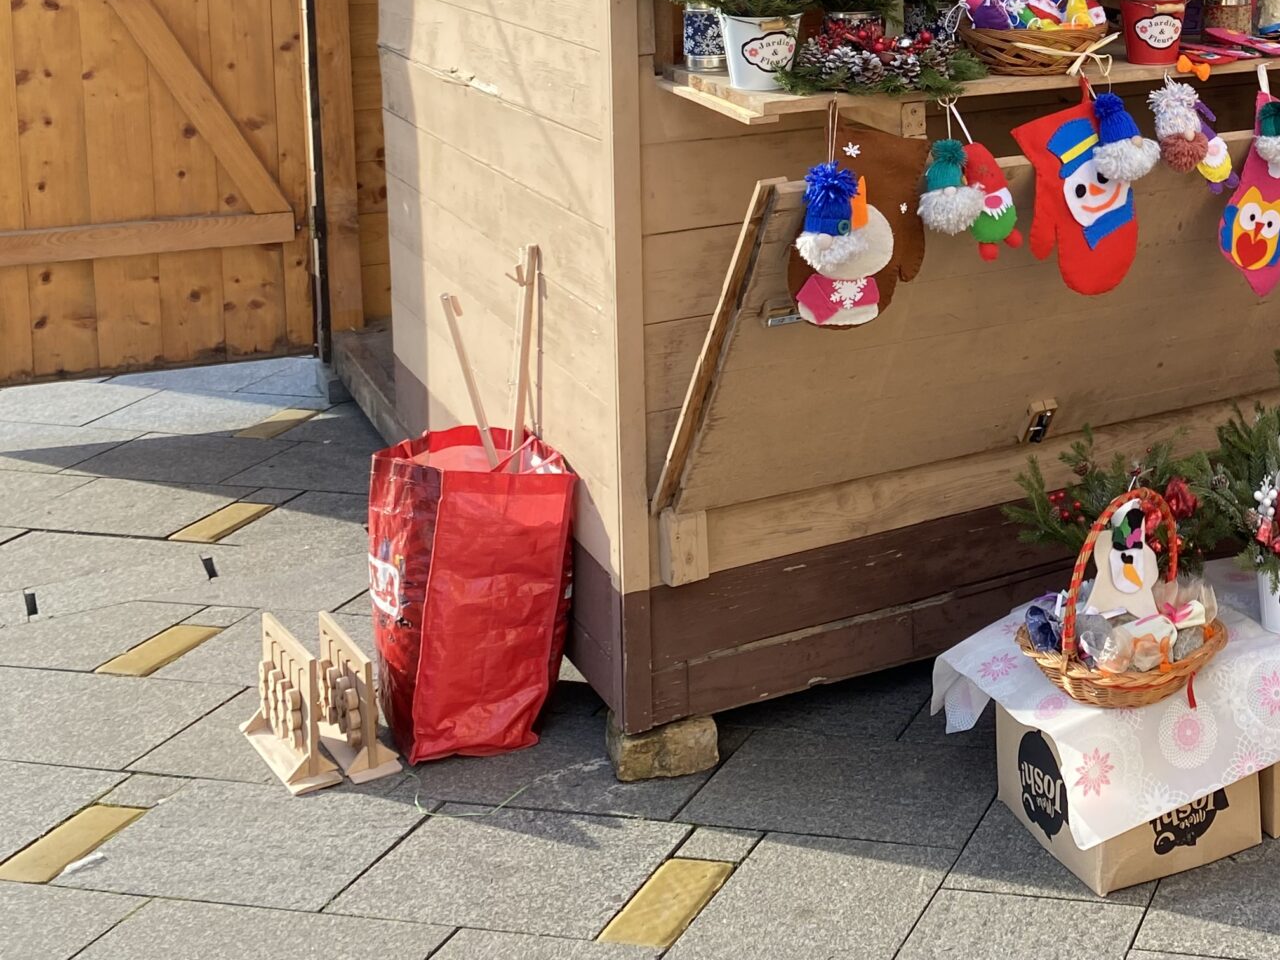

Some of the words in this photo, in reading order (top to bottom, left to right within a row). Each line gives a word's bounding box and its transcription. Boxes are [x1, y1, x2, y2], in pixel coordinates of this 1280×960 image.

[1148, 19, 1176, 28] Jardin
[759, 38, 790, 50] Jardin
[1148, 34, 1174, 44] Fleurs
[771, 48, 779, 57] &
[1020, 761, 1064, 815] Josh!
